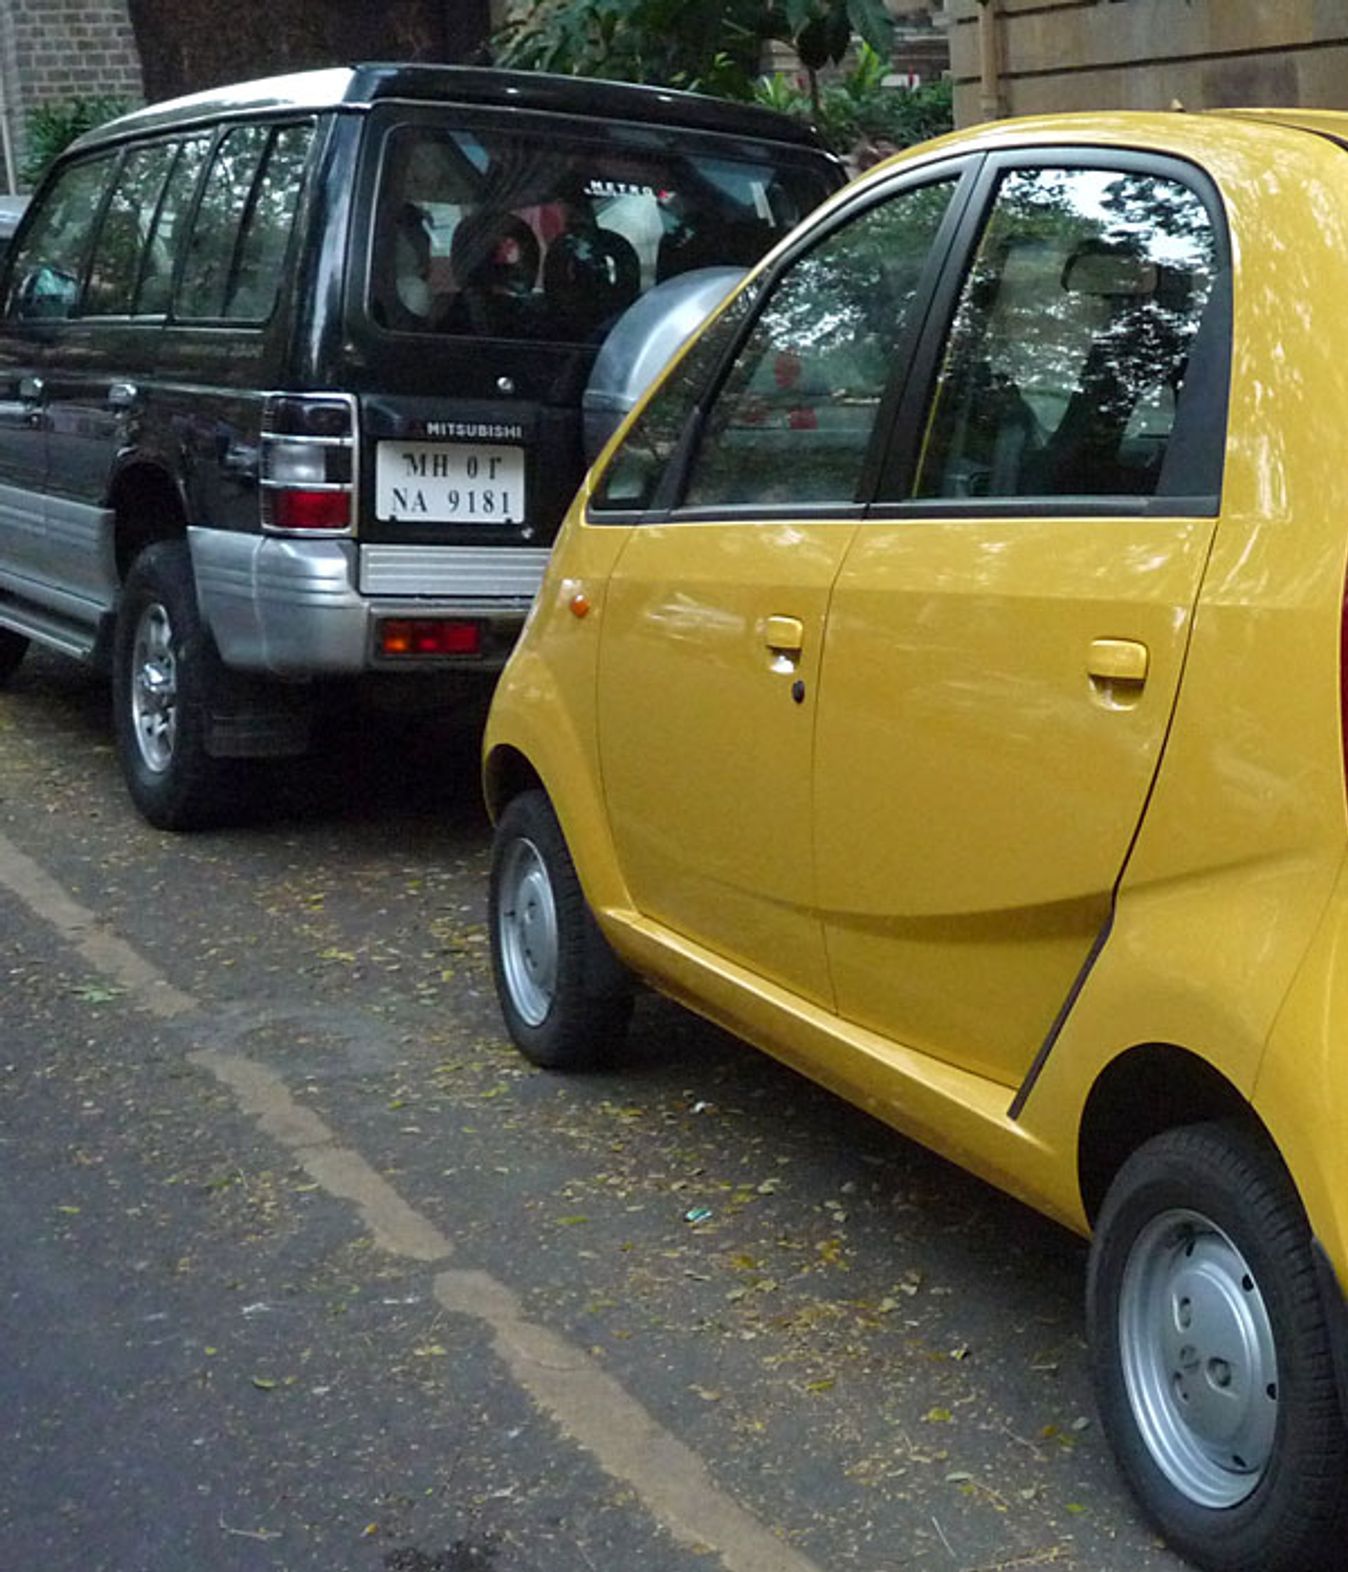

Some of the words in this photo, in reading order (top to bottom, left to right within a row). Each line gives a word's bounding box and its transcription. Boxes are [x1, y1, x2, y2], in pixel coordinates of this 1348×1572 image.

[427, 421, 522, 438] MITSUBISHI
[402, 453, 449, 477] MH
[392, 487, 427, 513] NA
[448, 489, 509, 514] 9181
